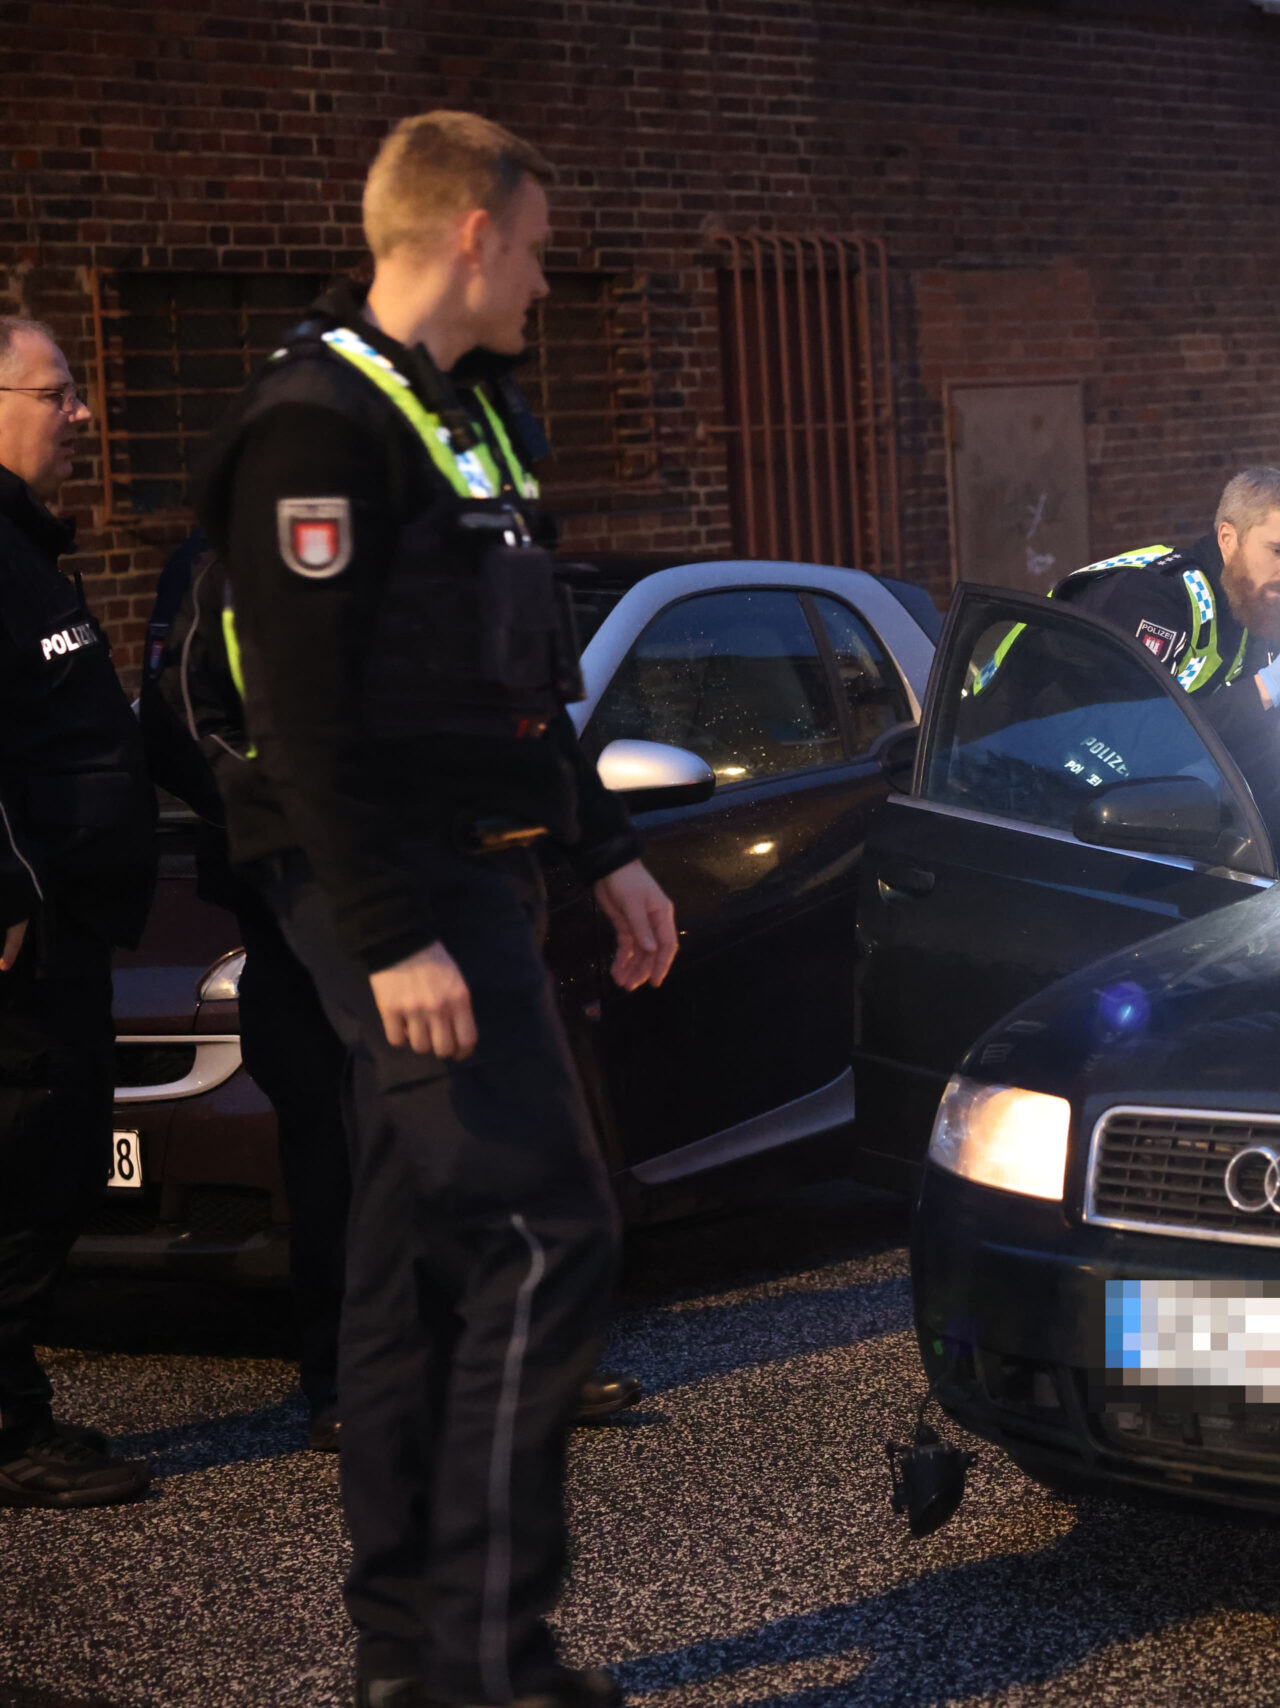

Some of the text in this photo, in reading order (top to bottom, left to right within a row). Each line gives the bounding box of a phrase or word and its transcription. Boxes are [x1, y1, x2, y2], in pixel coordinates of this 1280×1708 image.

[1141, 623, 1174, 640] POLIZEI
[1080, 736, 1130, 777] POLIZE
[107, 1138, 135, 1181] 8
